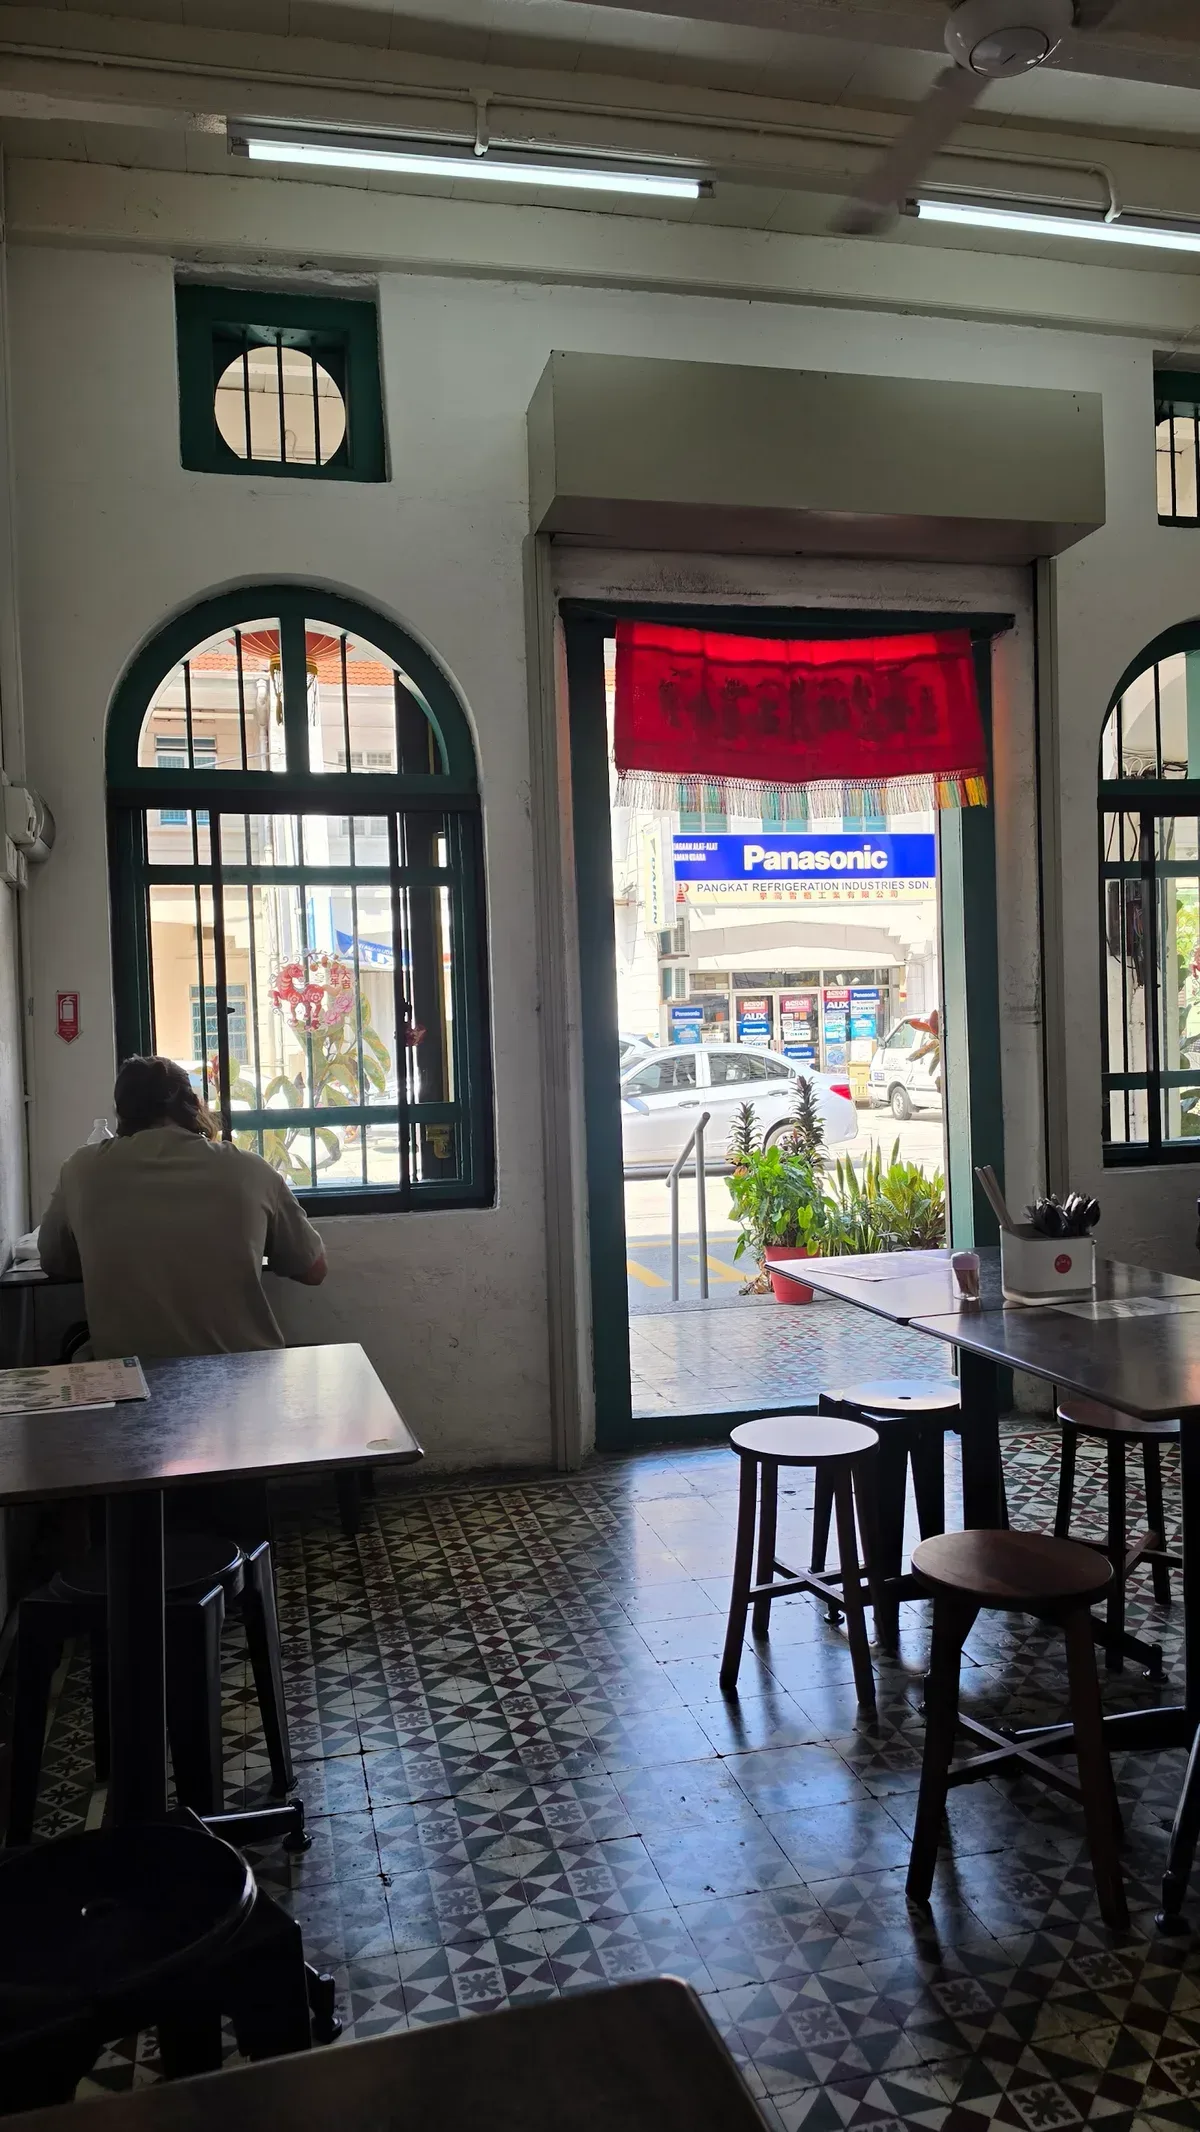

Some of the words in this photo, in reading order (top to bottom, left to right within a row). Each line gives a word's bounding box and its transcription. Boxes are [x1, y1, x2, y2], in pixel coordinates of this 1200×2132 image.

[743, 844, 888, 871] Panasonic
[697, 883, 748, 892] PANGKAT
[752, 882, 839, 892] REFRIGERATION
[841, 881, 905, 890] INDUSTRIES
[908, 881, 932, 890] SDN.
[341, 970, 351, 989] 大吉
[826, 1001, 849, 1009] AUX
[744, 1012, 766, 1020] AUX
